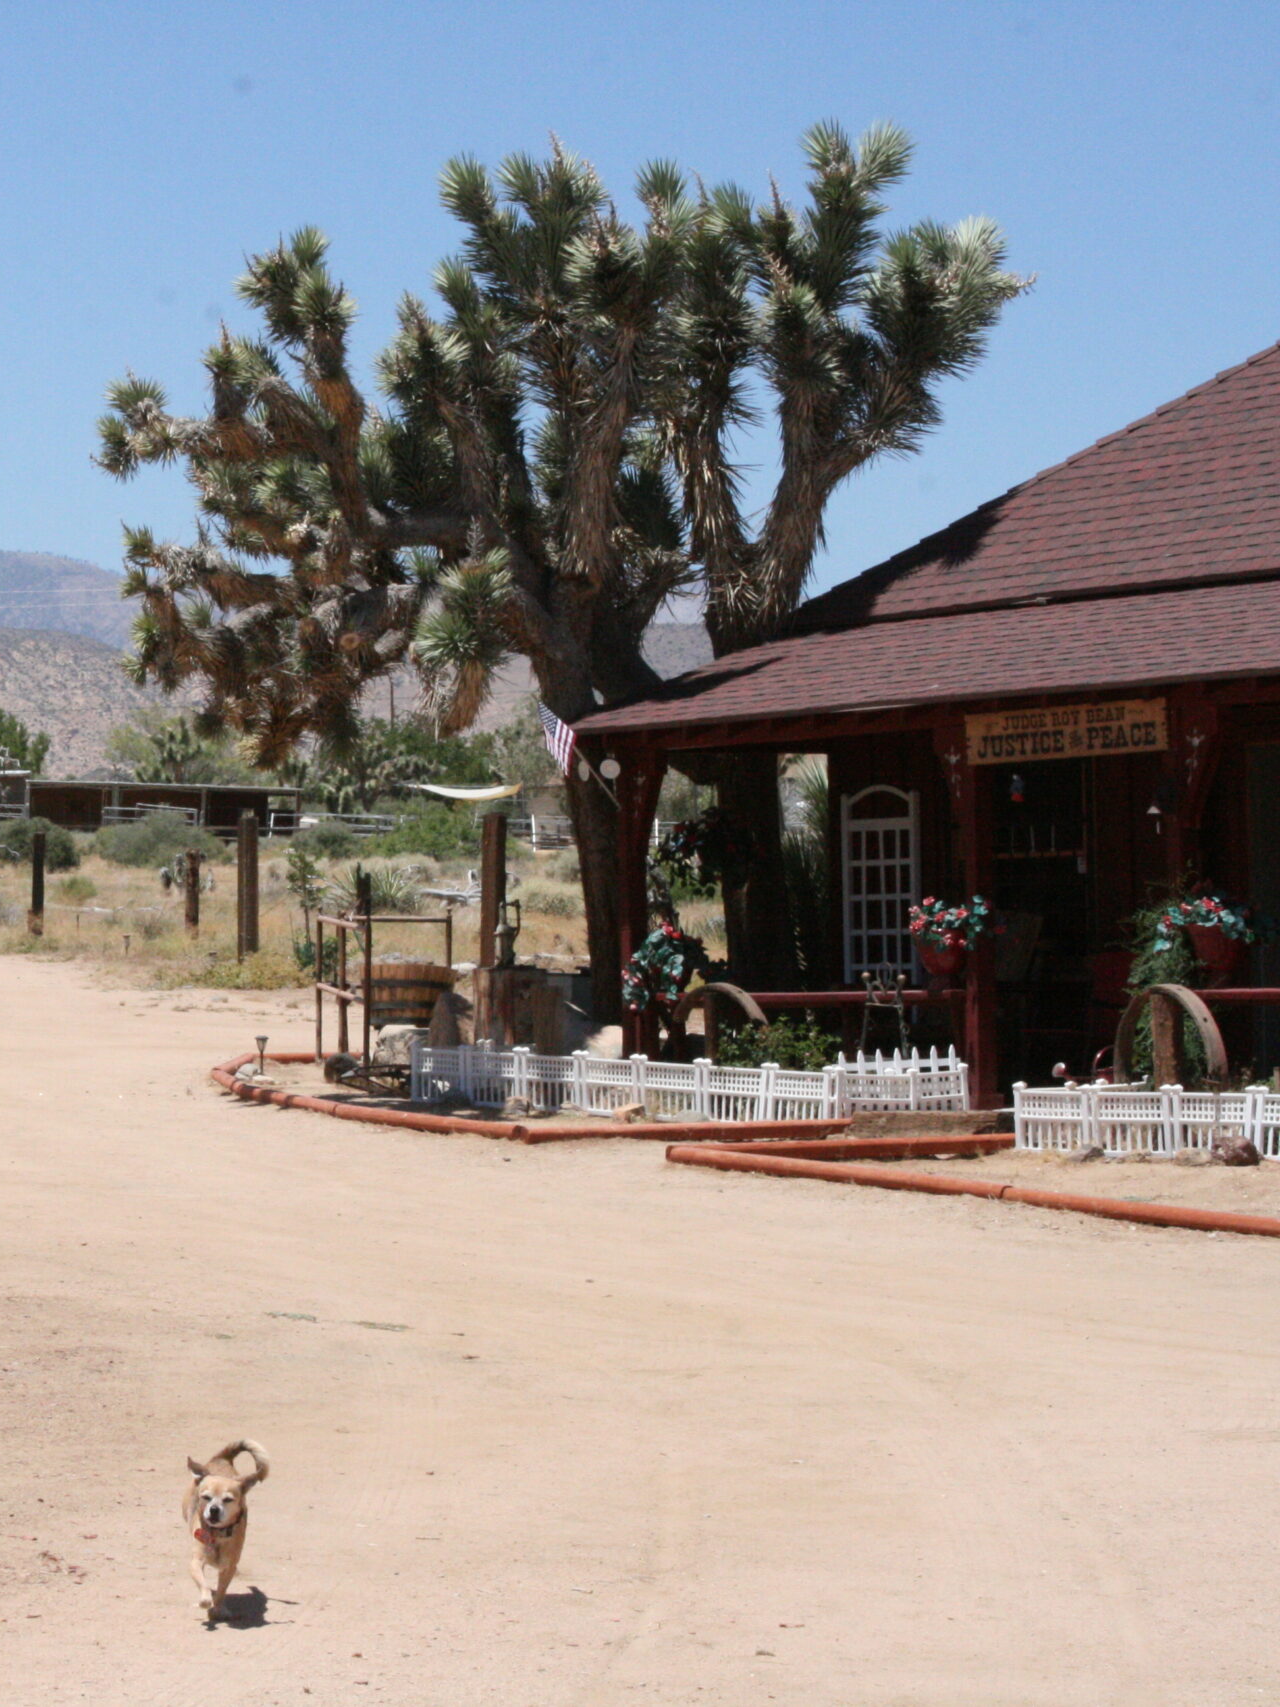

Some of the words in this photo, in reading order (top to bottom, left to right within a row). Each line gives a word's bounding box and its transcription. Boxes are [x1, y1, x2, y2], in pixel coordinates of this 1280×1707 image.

[1003, 712, 1047, 731] JUDGE
[1052, 710, 1080, 727] ROY
[1086, 706, 1125, 724] BEAN
[978, 730, 1064, 758] JUSTICE
[1087, 722, 1156, 750] PEACE
